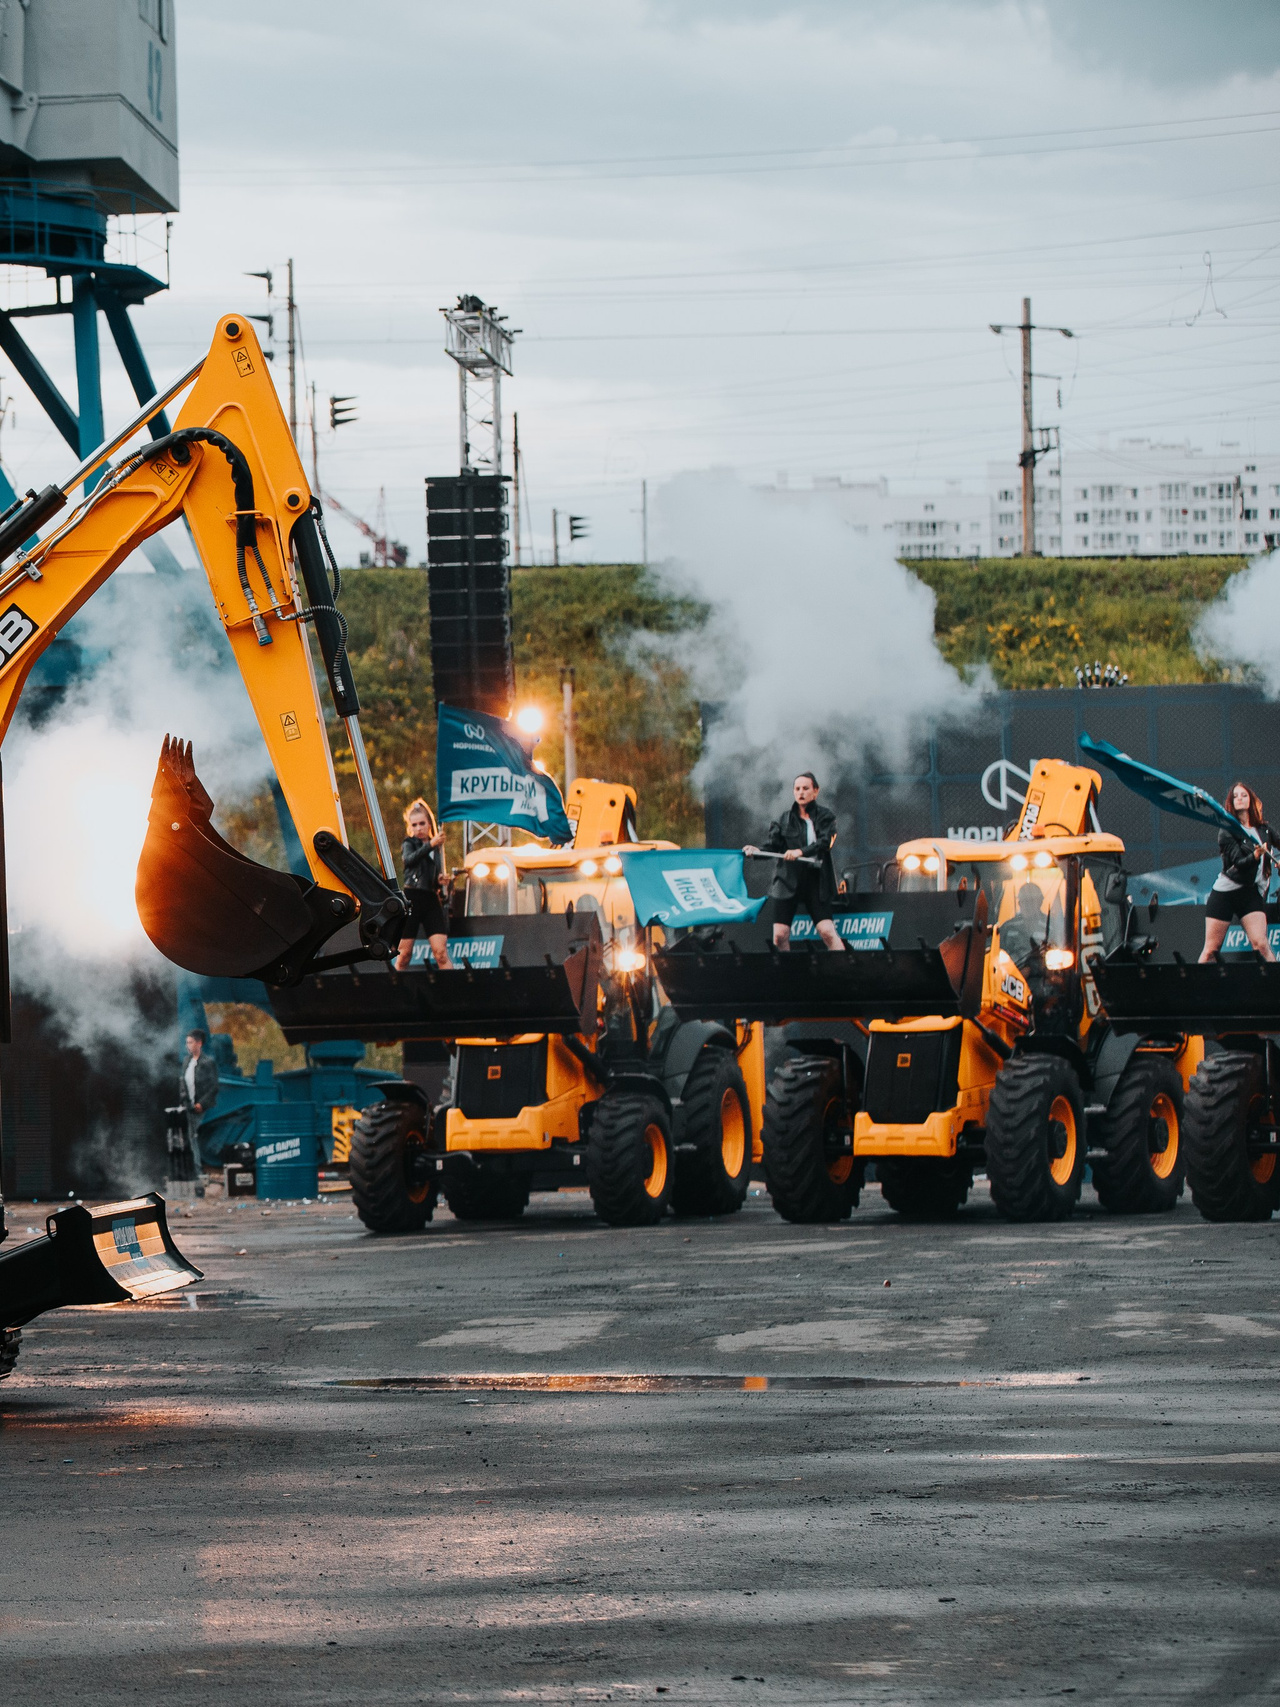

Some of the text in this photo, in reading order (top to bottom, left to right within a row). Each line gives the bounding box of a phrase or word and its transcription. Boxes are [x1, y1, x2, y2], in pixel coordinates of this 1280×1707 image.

[790, 917, 885, 936] КРУЕ ПАРНИ
[452, 941, 496, 958] ПАРНИ
[1001, 974, 1024, 1003] JCB
